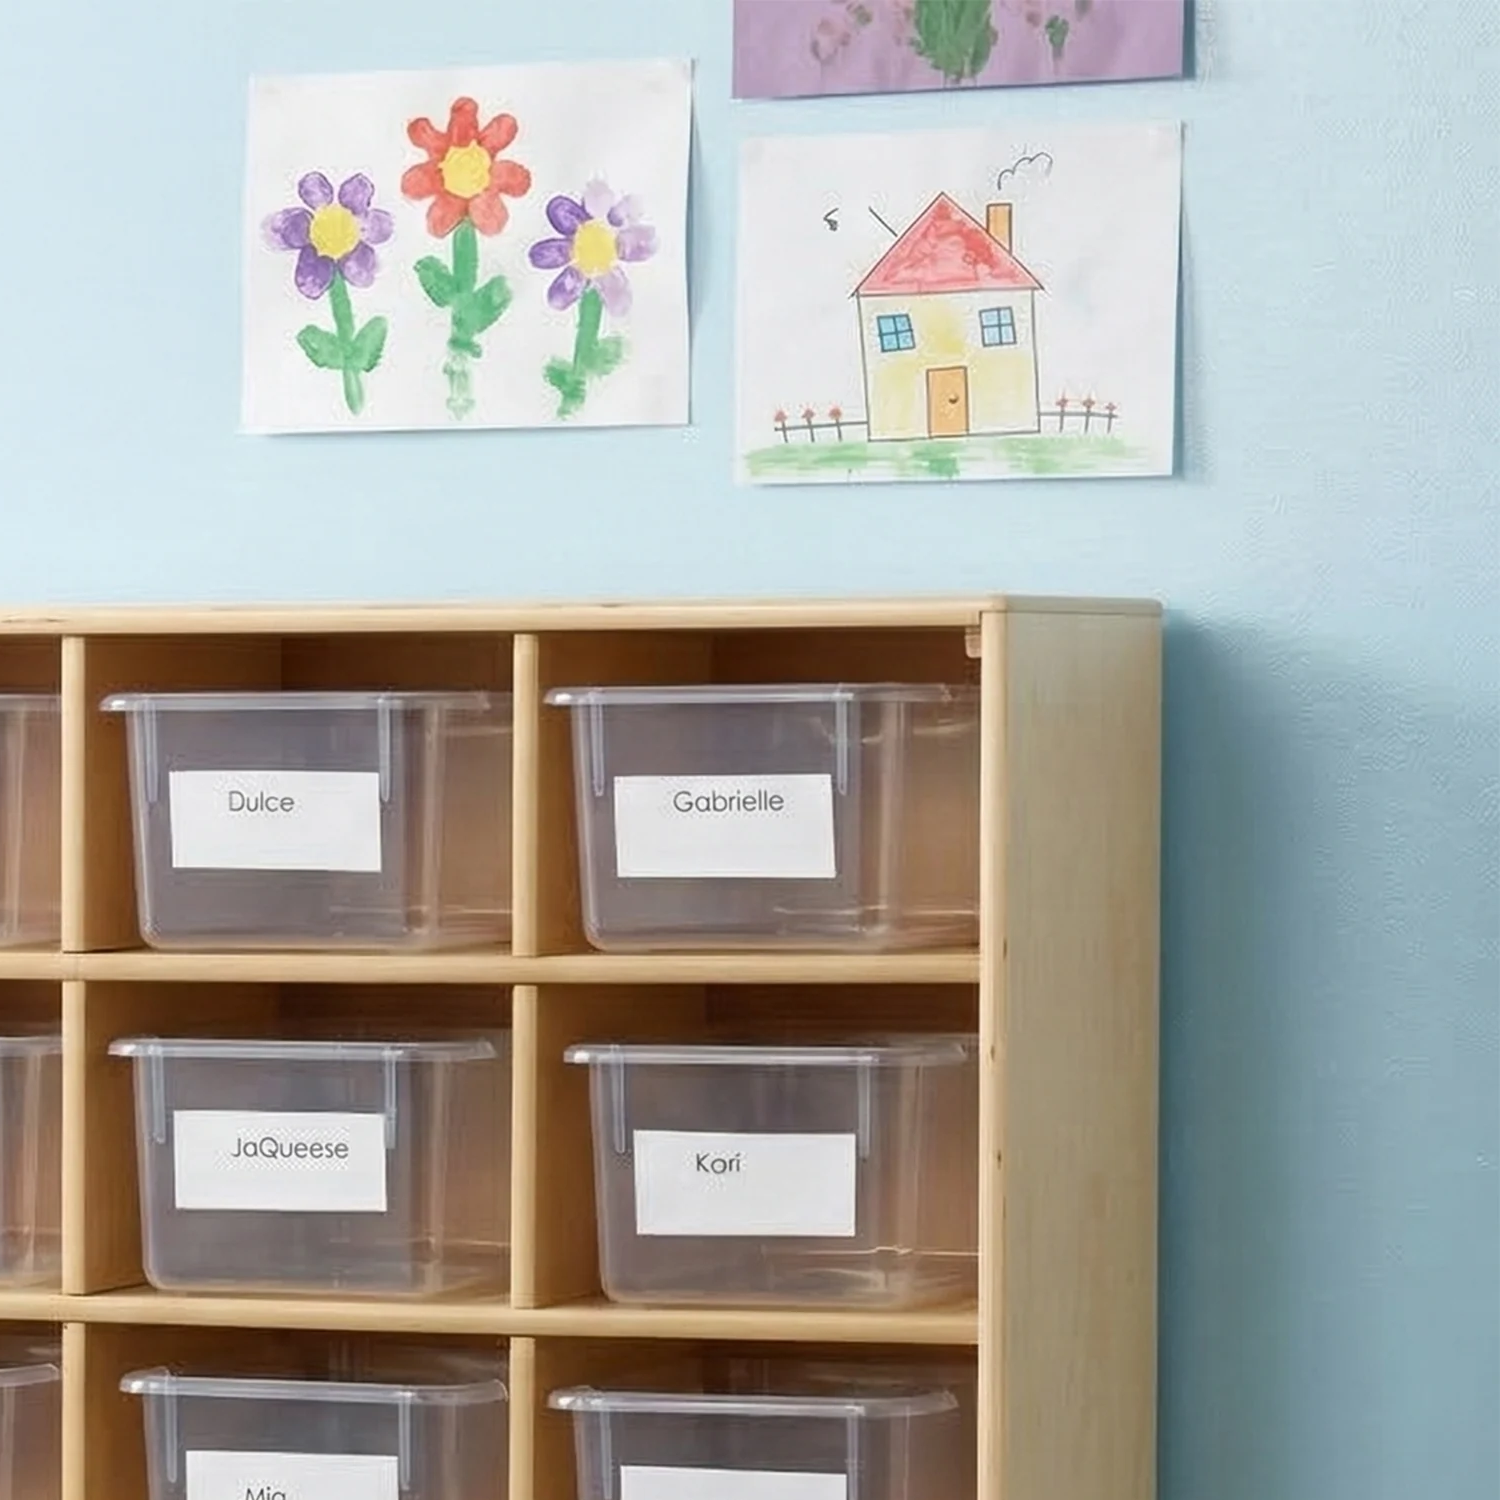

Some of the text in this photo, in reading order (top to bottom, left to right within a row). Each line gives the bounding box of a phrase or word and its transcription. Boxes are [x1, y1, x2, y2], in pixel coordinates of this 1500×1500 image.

[228, 790, 296, 813] Dulce
[672, 788, 785, 813] Gabrielle
[230, 1136, 350, 1160] JaQueese
